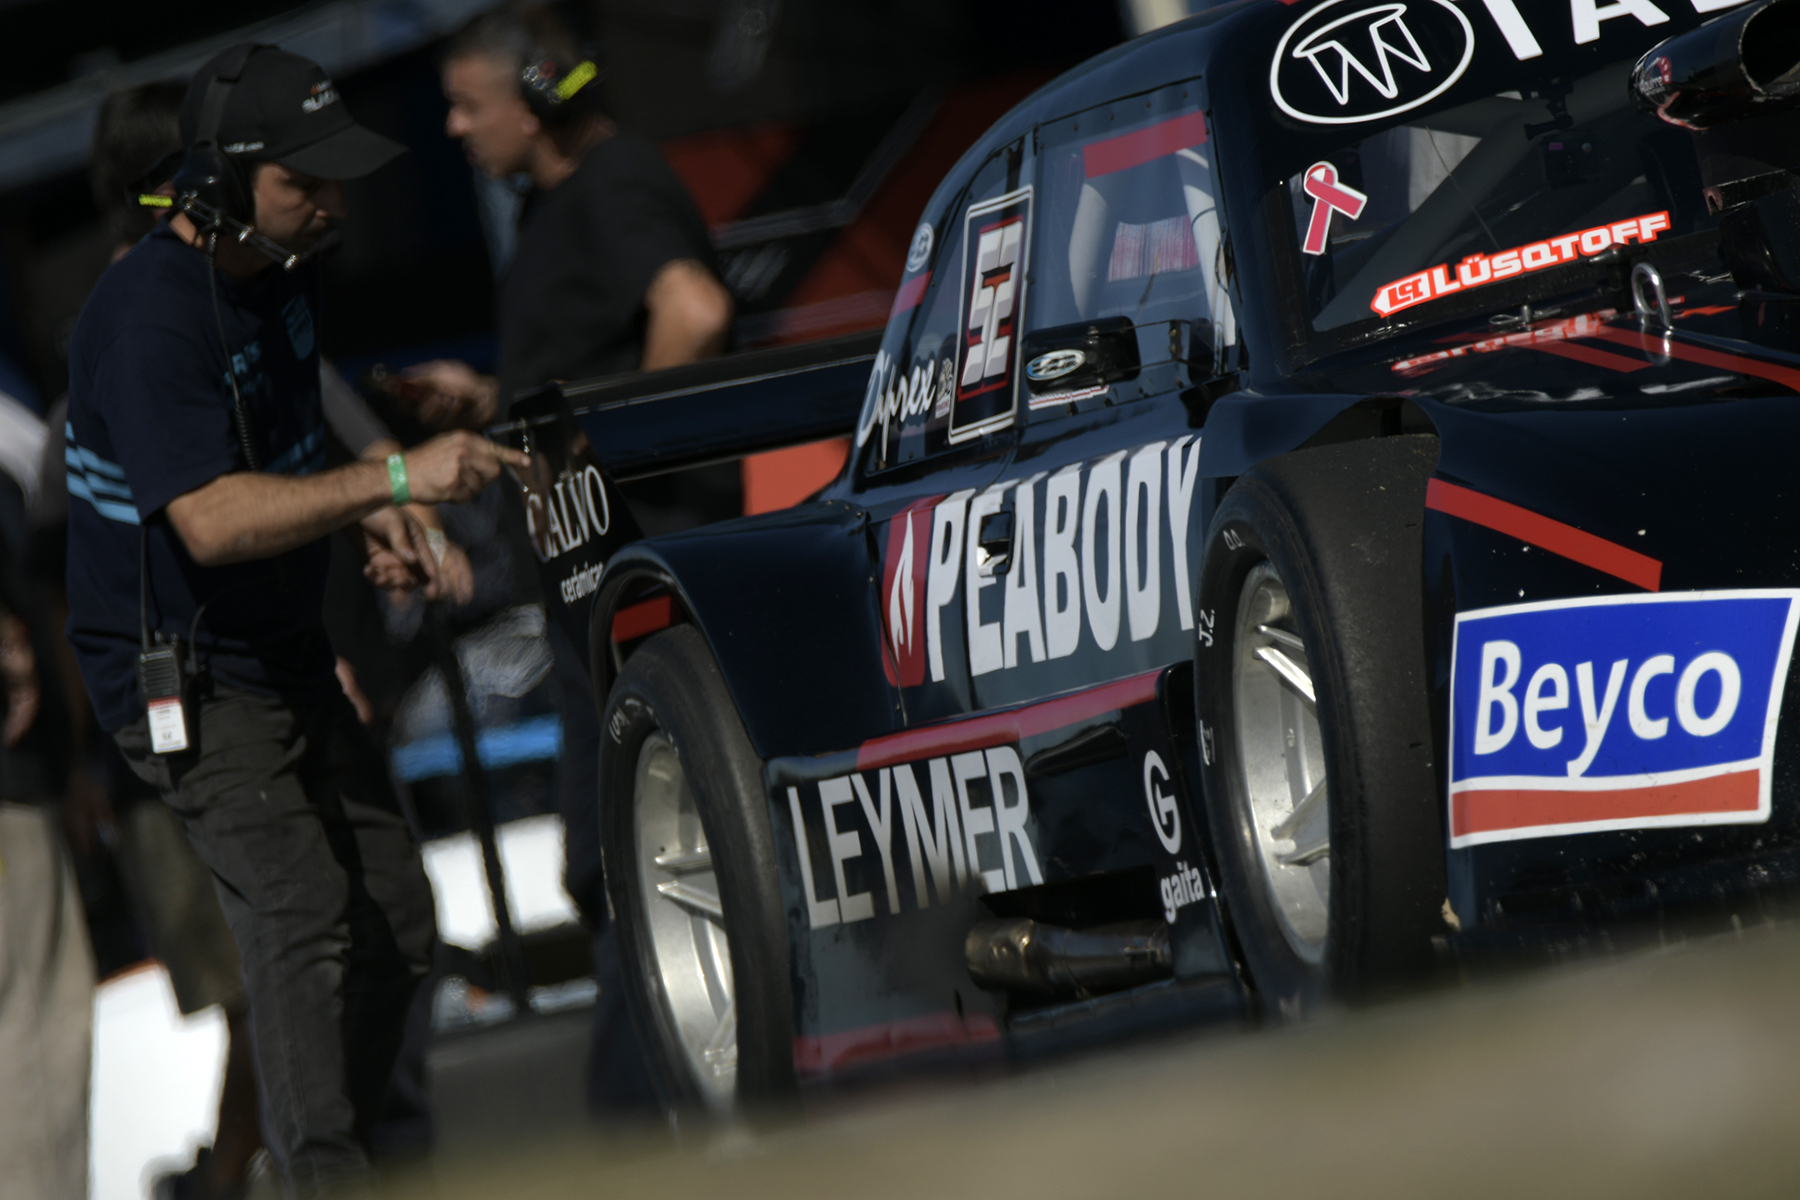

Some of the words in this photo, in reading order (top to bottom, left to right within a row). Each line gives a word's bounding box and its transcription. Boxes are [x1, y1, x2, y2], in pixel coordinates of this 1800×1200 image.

[526, 464, 610, 563] CALVO
[926, 433, 1202, 683] PEABODY
[1474, 639, 1741, 777] Beyco
[787, 745, 1044, 930] LEYMER
[1160, 860, 1205, 924] gaita
